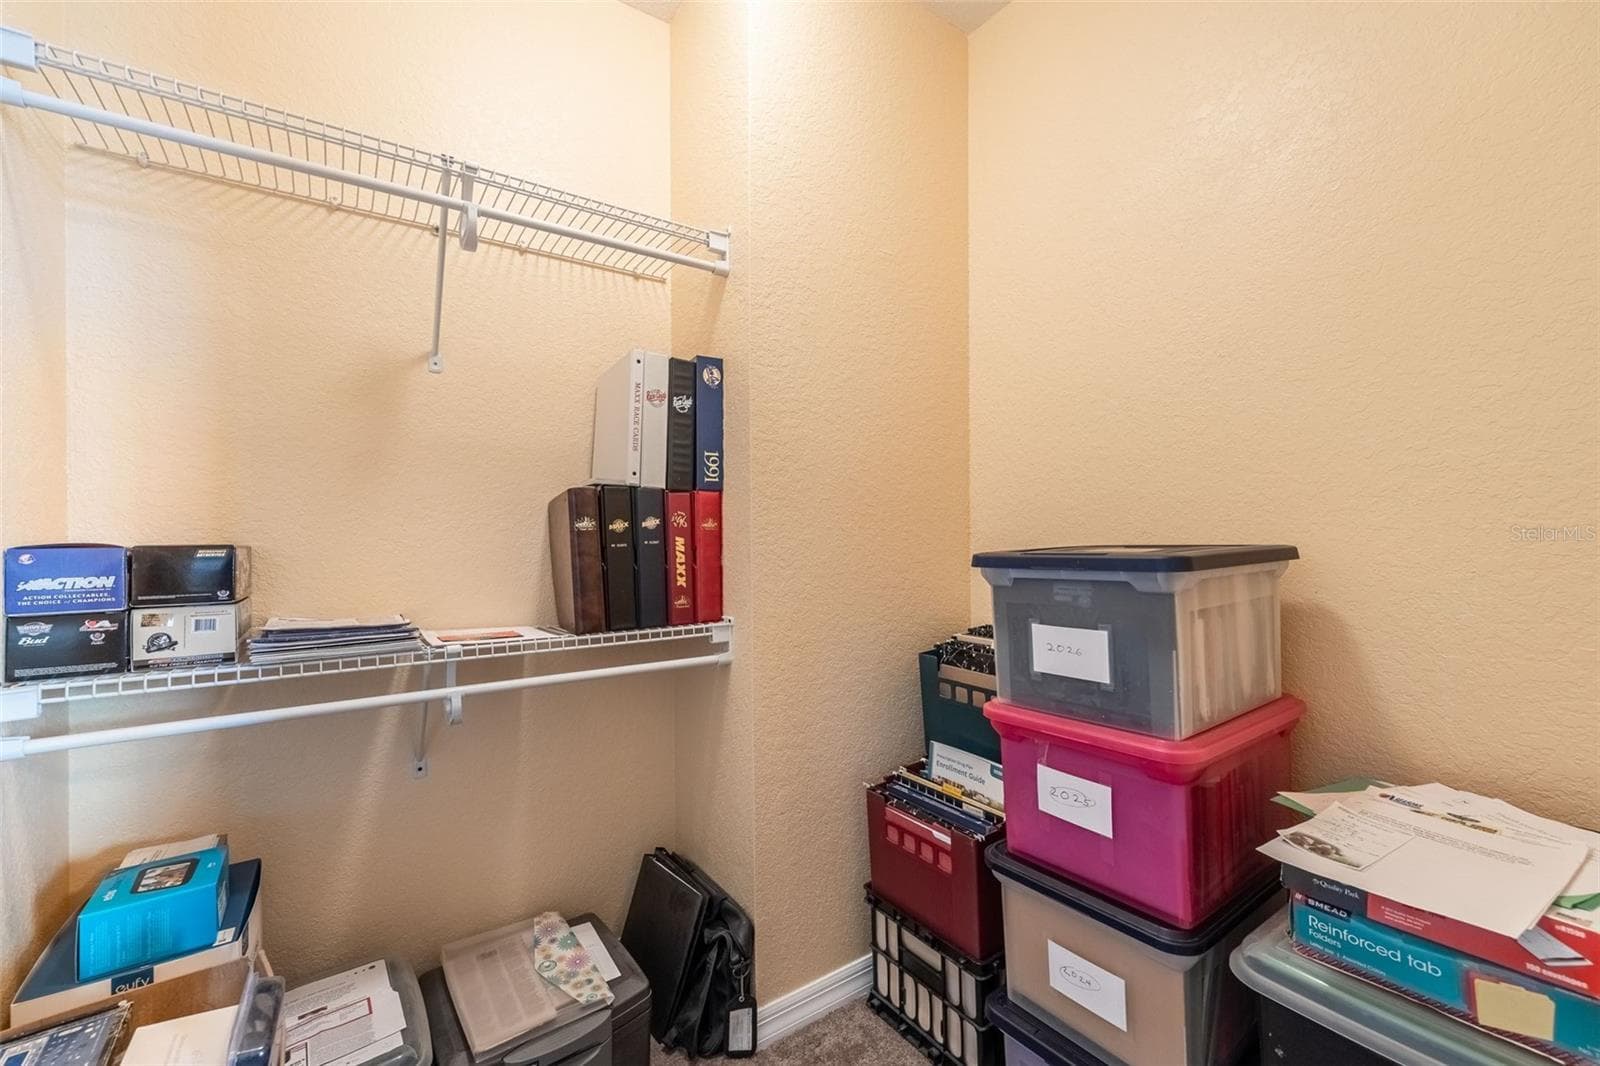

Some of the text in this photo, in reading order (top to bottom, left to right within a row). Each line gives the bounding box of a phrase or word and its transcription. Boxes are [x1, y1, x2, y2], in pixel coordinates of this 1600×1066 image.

[703, 451, 721, 482] 1991
[675, 536, 687, 588] MAXX
[18, 636, 50, 646] Bud
[1046, 642, 1082, 656] 2026
[936, 760, 968, 778] Enrollment
[968, 773, 986, 785] Guide
[1050, 786, 1091, 808] 2025
[1319, 880, 1360, 899] Quality Park
[1308, 898, 1348, 918] SMEAD
[1308, 928, 1342, 949] Folders
[1308, 915, 1402, 962] Reinforced
[1408, 954, 1442, 977] tab
[115, 977, 150, 994] eufy
[1062, 965, 1092, 987] 2024
